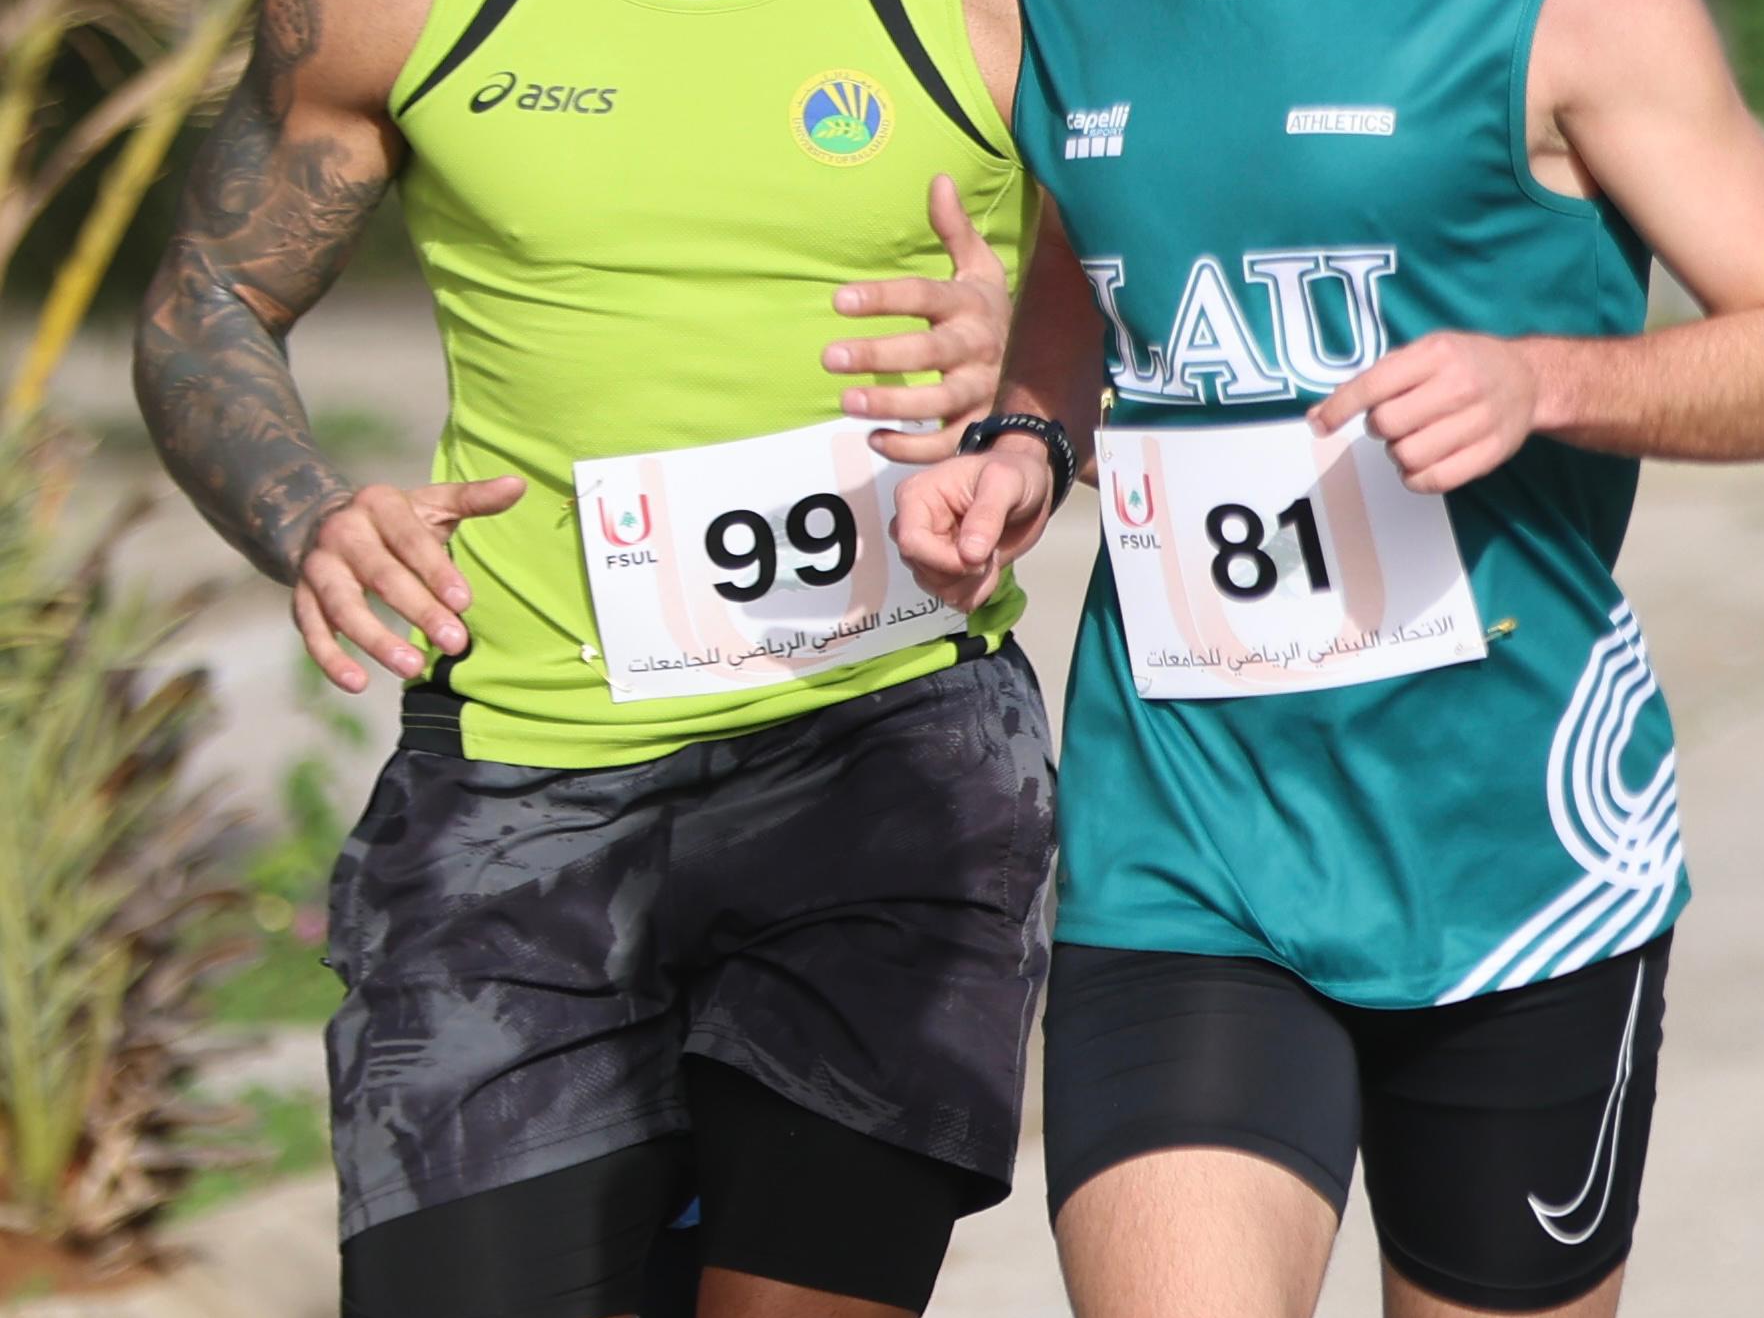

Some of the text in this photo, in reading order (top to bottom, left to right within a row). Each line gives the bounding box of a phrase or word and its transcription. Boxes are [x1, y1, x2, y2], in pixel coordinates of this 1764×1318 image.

[516, 83, 618, 114] asics
[1066, 104, 1130, 135] capelli
[1088, 128, 1124, 138] SPORT
[1289, 114, 1393, 133] ATHLETICS
[1080, 249, 1396, 405] LAU
[704, 493, 857, 603] 99
[1120, 534, 1161, 550] FSUL
[1205, 497, 1332, 603] 81
[606, 549, 658, 569] FSUL
[627, 594, 945, 674] الاتحاد اللبناني الرياضي للجامعات
[1147, 616, 1454, 676] الاتحاد اللبناني الرياضي للجامعات
